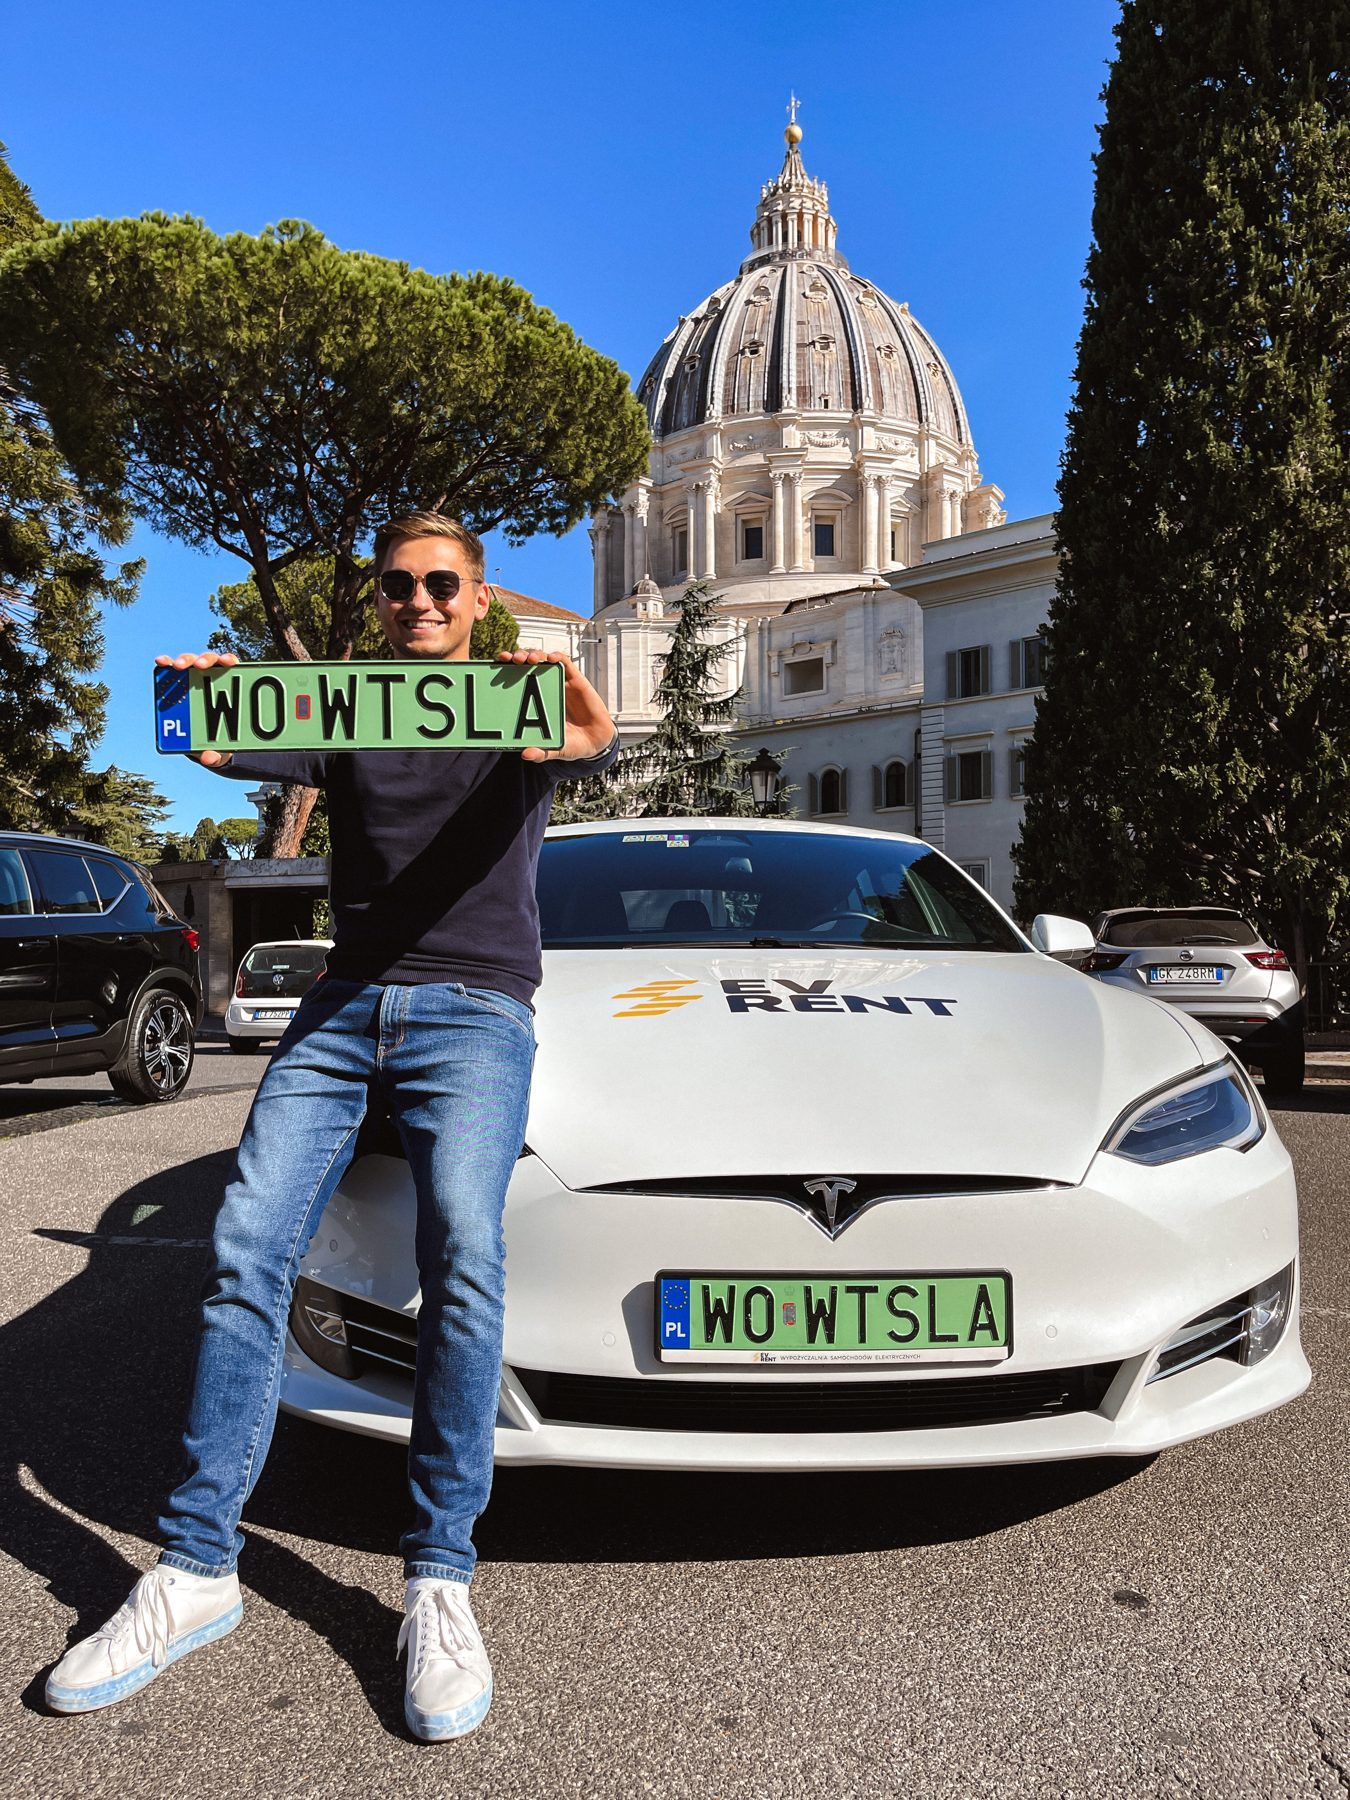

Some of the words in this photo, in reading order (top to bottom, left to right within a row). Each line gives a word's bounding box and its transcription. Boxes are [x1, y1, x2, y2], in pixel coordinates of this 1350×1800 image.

[163, 719, 187, 737] PL
[203, 675, 286, 741] WO
[318, 673, 553, 741] WTSLA
[720, 979, 834, 994] EV
[726, 994, 958, 1016] RENT
[665, 1322, 687, 1338] PL
[702, 1285, 775, 1344] WO
[803, 1284, 1000, 1344] WTSLA
